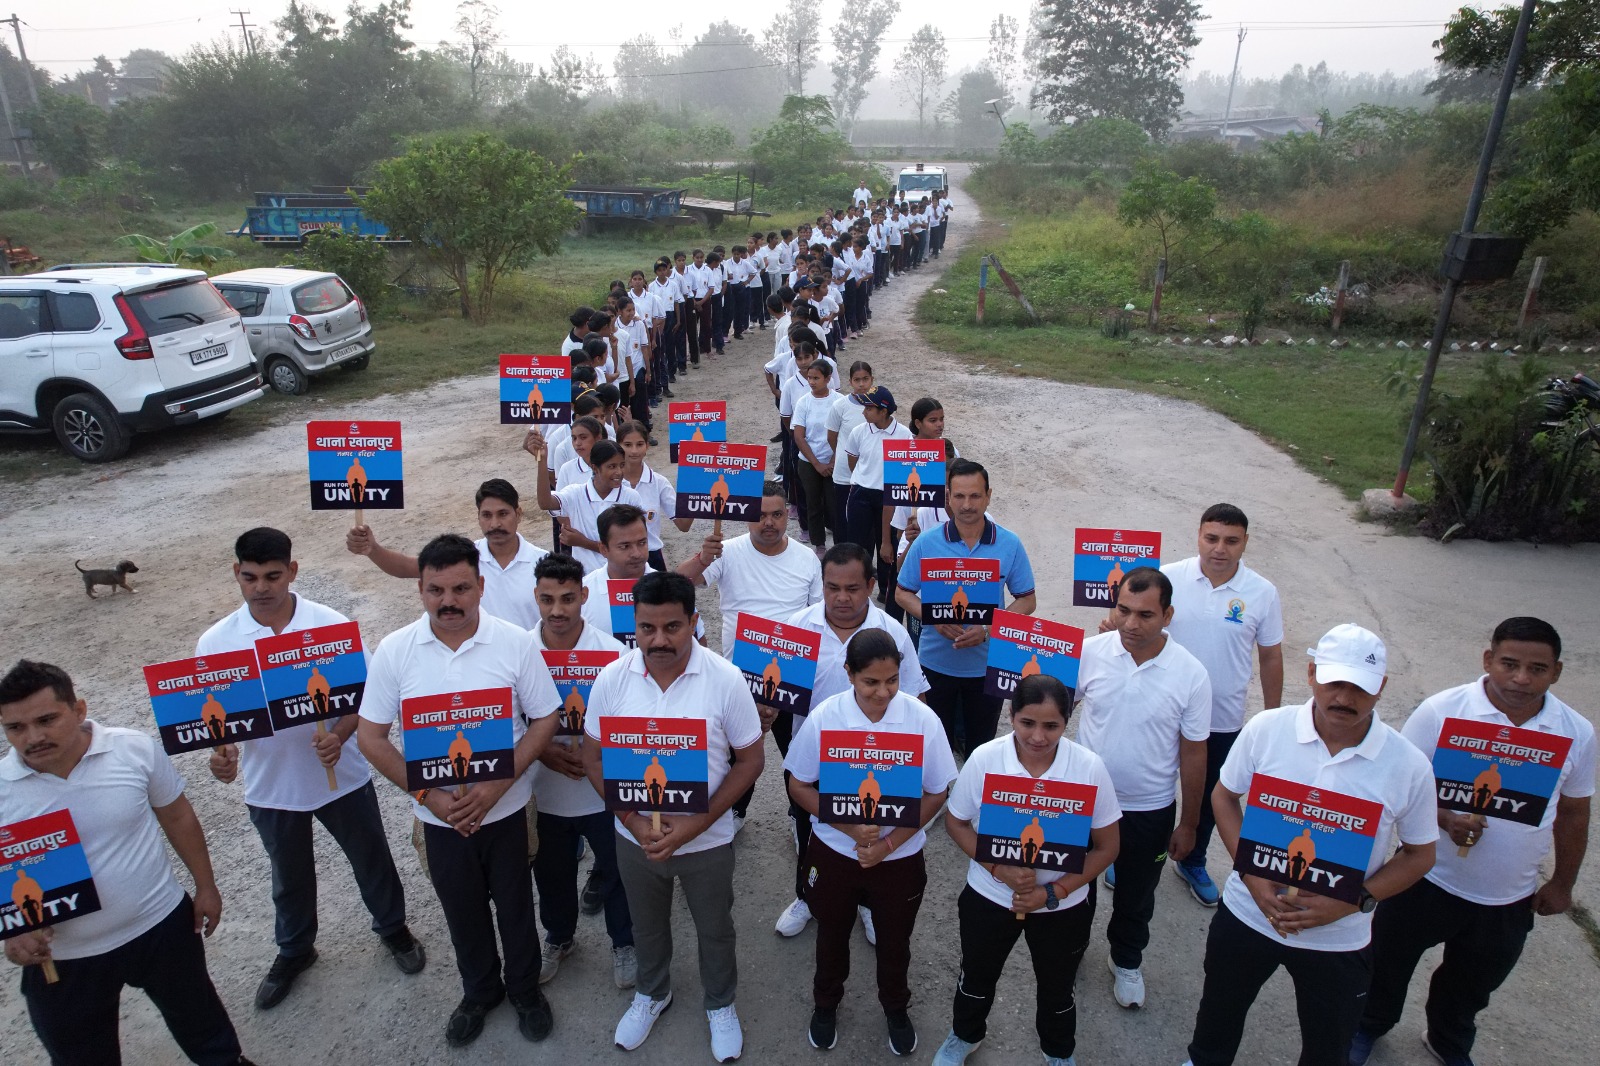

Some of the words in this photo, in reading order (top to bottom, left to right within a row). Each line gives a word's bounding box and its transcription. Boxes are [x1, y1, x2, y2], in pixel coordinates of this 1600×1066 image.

[505, 366, 529, 375] थाना
[673, 412, 692, 420] थाना
[316, 436, 346, 447] थाना
[347, 436, 394, 451] खानपुर
[686, 453, 714, 464] थाना
[715, 455, 759, 470] खानपुर
[887, 450, 908, 458] थाना
[1082, 541, 1110, 552] थाना
[1110, 543, 1154, 558] खानपुर
[927, 569, 952, 578] थाना
[953, 570, 993, 581] खानपुर
[742, 628, 770, 644] थाना
[770, 635, 812, 658] खानपुर
[999, 625, 1028, 642] थाना
[1029, 632, 1075, 655] खानपुर
[268, 648, 301, 664] थाना
[301, 638, 352, 658] खानपुर
[157, 674, 194, 690] थाना
[194, 665, 250, 684] खानपुर
[999, 670, 1010, 678] RUN
[283, 697, 297, 705] RUN
[412, 710, 448, 724] थाना
[449, 704, 503, 720] खानपुर
[175, 723, 190, 731] RUN
[609, 732, 643, 744] थाना
[644, 733, 697, 750] खानपुर
[1447, 734, 1490, 751] थाना
[1490, 740, 1555, 764] खानपुर
[828, 747, 861, 759] थाना
[862, 748, 914, 765] खानपुर
[1440, 780, 1457, 788] RUN
[991, 789, 1028, 804] थाना
[1029, 794, 1085, 814] खानपुर
[1258, 792, 1300, 813] थाना
[1301, 802, 1367, 832] खानपुर
[0, 830, 68, 858] खानपुर
[1254, 844, 1271, 854] RUN
[1272, 849, 1288, 858] FOR
[1, 904, 18, 914] FOR
